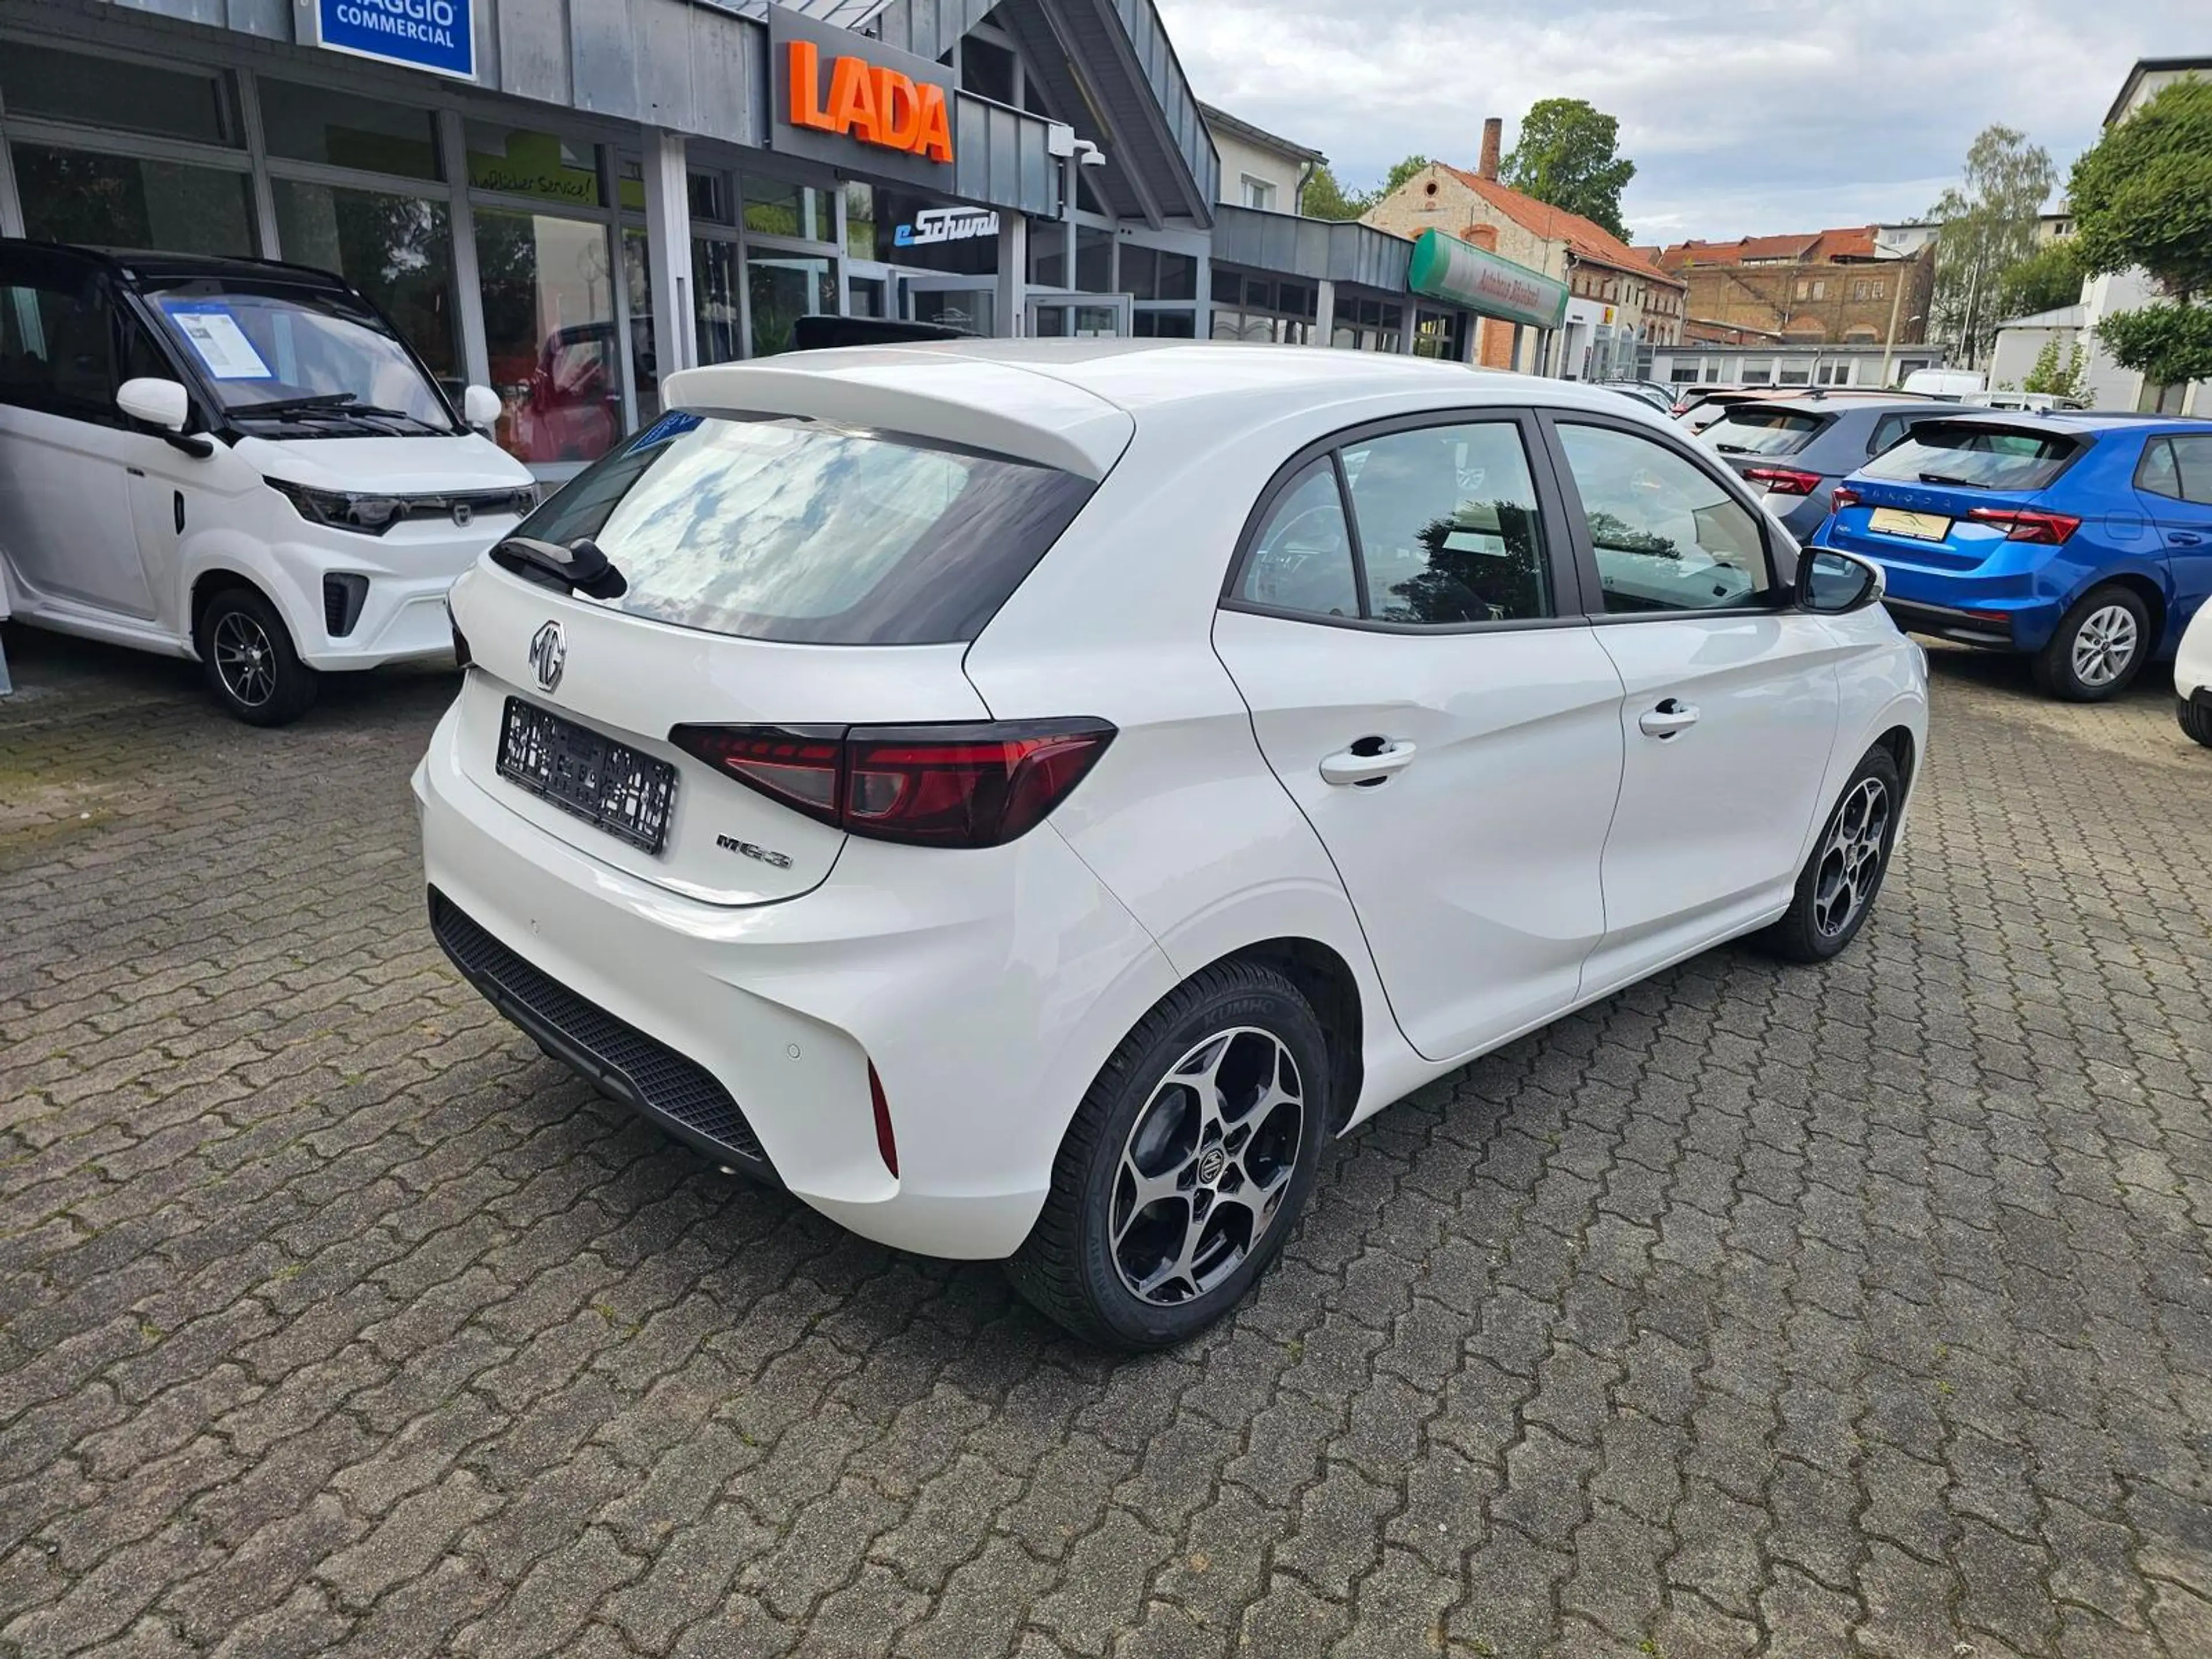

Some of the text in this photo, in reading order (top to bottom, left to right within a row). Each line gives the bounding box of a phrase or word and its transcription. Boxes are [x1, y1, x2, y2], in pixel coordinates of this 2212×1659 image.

[337, 4, 454, 48] COMMERCIAL
[355, 0, 453, 26] GGIO
[789, 40, 953, 164] LADA
[537, 174, 592, 202] Service!
[529, 622, 566, 691] MG
[716, 832, 793, 870] MG3
[1205, 999, 1275, 1029] KUMHO
